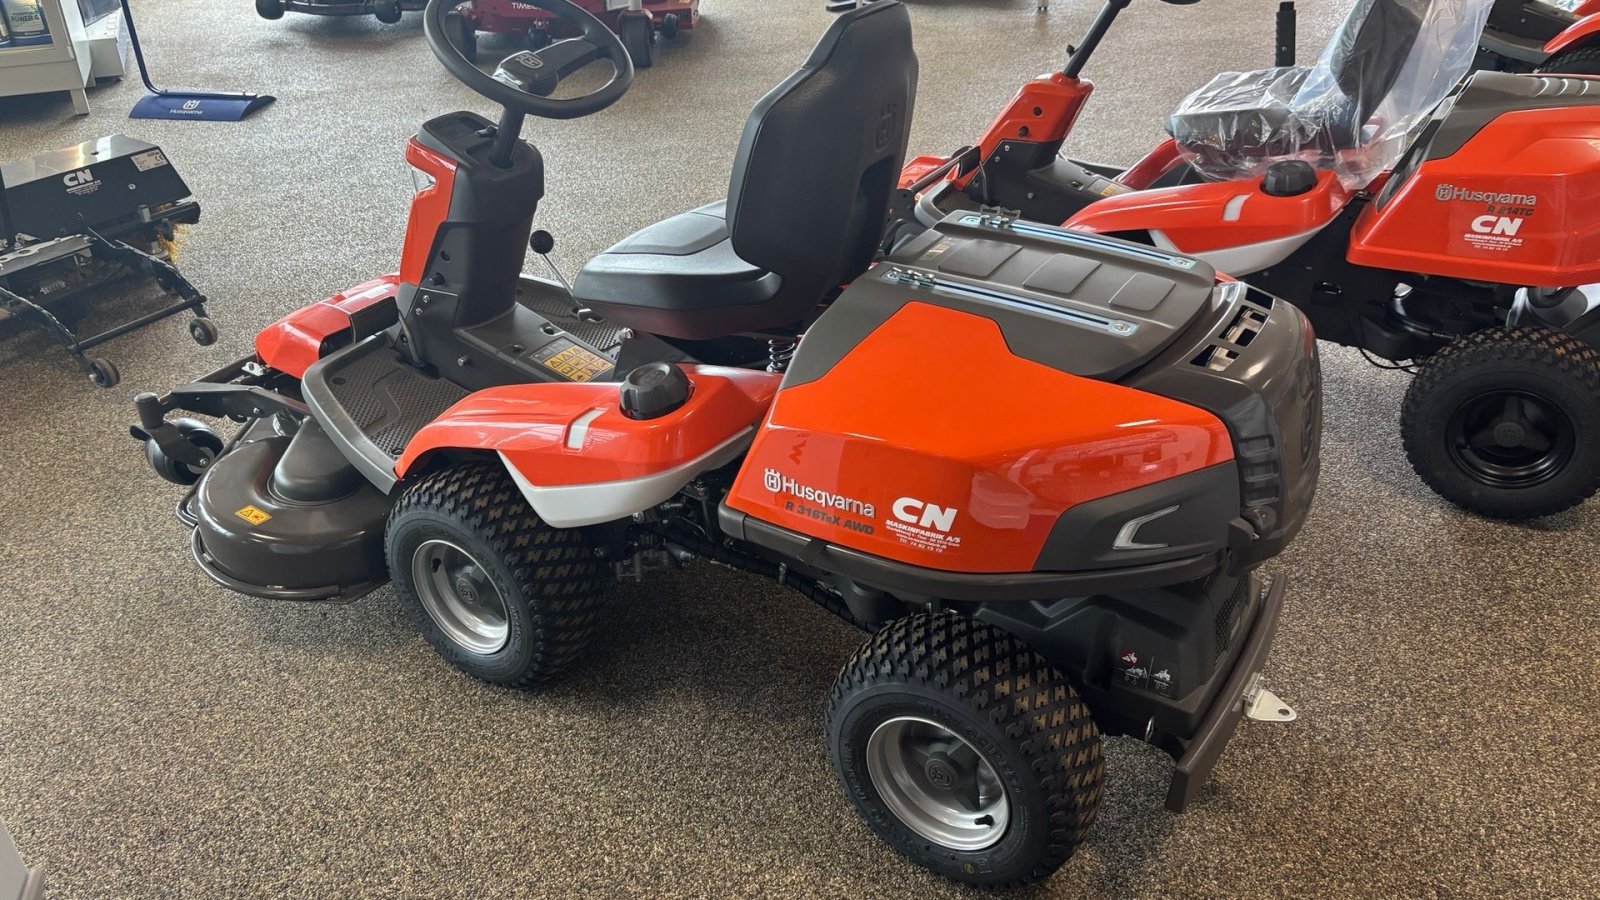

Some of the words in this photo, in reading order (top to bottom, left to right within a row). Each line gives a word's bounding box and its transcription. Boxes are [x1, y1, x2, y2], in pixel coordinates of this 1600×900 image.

[63, 168, 93, 186] CN
[1452, 187, 1536, 205] Husqvarna
[1487, 205, 1496, 213] R
[1499, 206, 1534, 216] 214TC
[1471, 215, 1524, 236] CN
[782, 475, 875, 519] Husqvarna
[785, 501, 794, 511] R
[844, 519, 874, 535] AWD
[892, 497, 958, 532] CN
[886, 519, 945, 541] MASKINFABRIK
[946, 536, 961, 544] A/S
